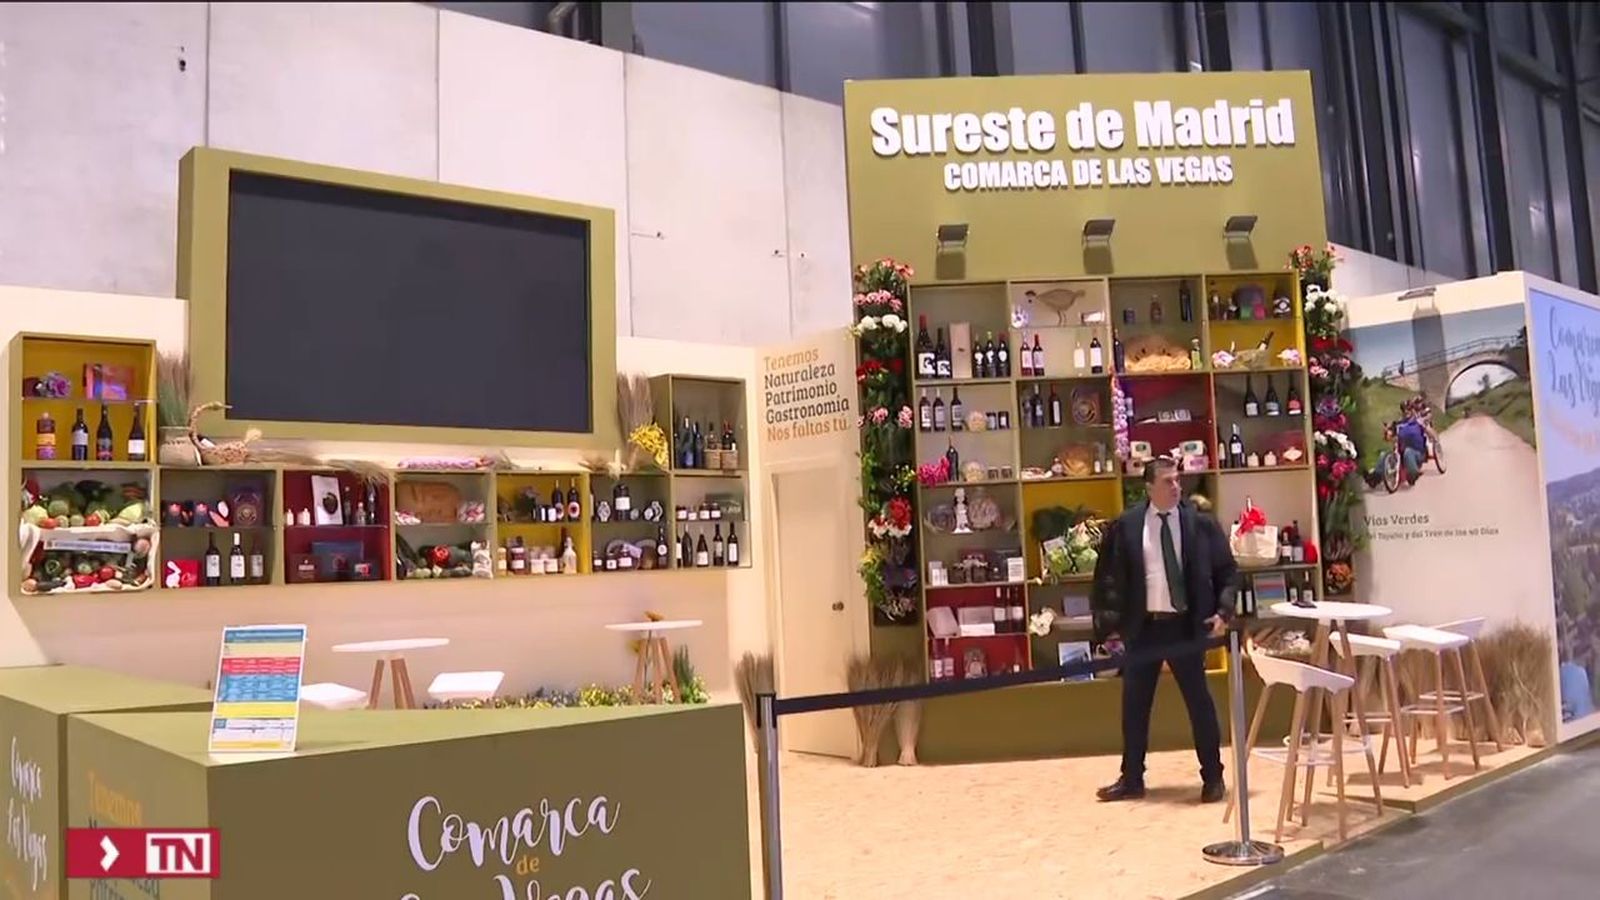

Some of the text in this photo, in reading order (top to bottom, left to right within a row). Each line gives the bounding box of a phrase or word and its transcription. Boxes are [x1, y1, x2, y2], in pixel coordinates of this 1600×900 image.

[870, 98, 1296, 157] Sureste de Madrid
[943, 155, 1233, 191] COMARCA DE LAS VEGAS
[764, 349, 819, 371] Tenemos
[764, 363, 836, 390] Naturaleza
[765, 380, 838, 407] Patrimonio
[767, 425, 790, 442] Nos
[793, 419, 830, 438] faltas
[1390, 513, 1429, 524] Verdes
[408, 796, 620, 871] Comarca
[516, 855, 540, 876] de
